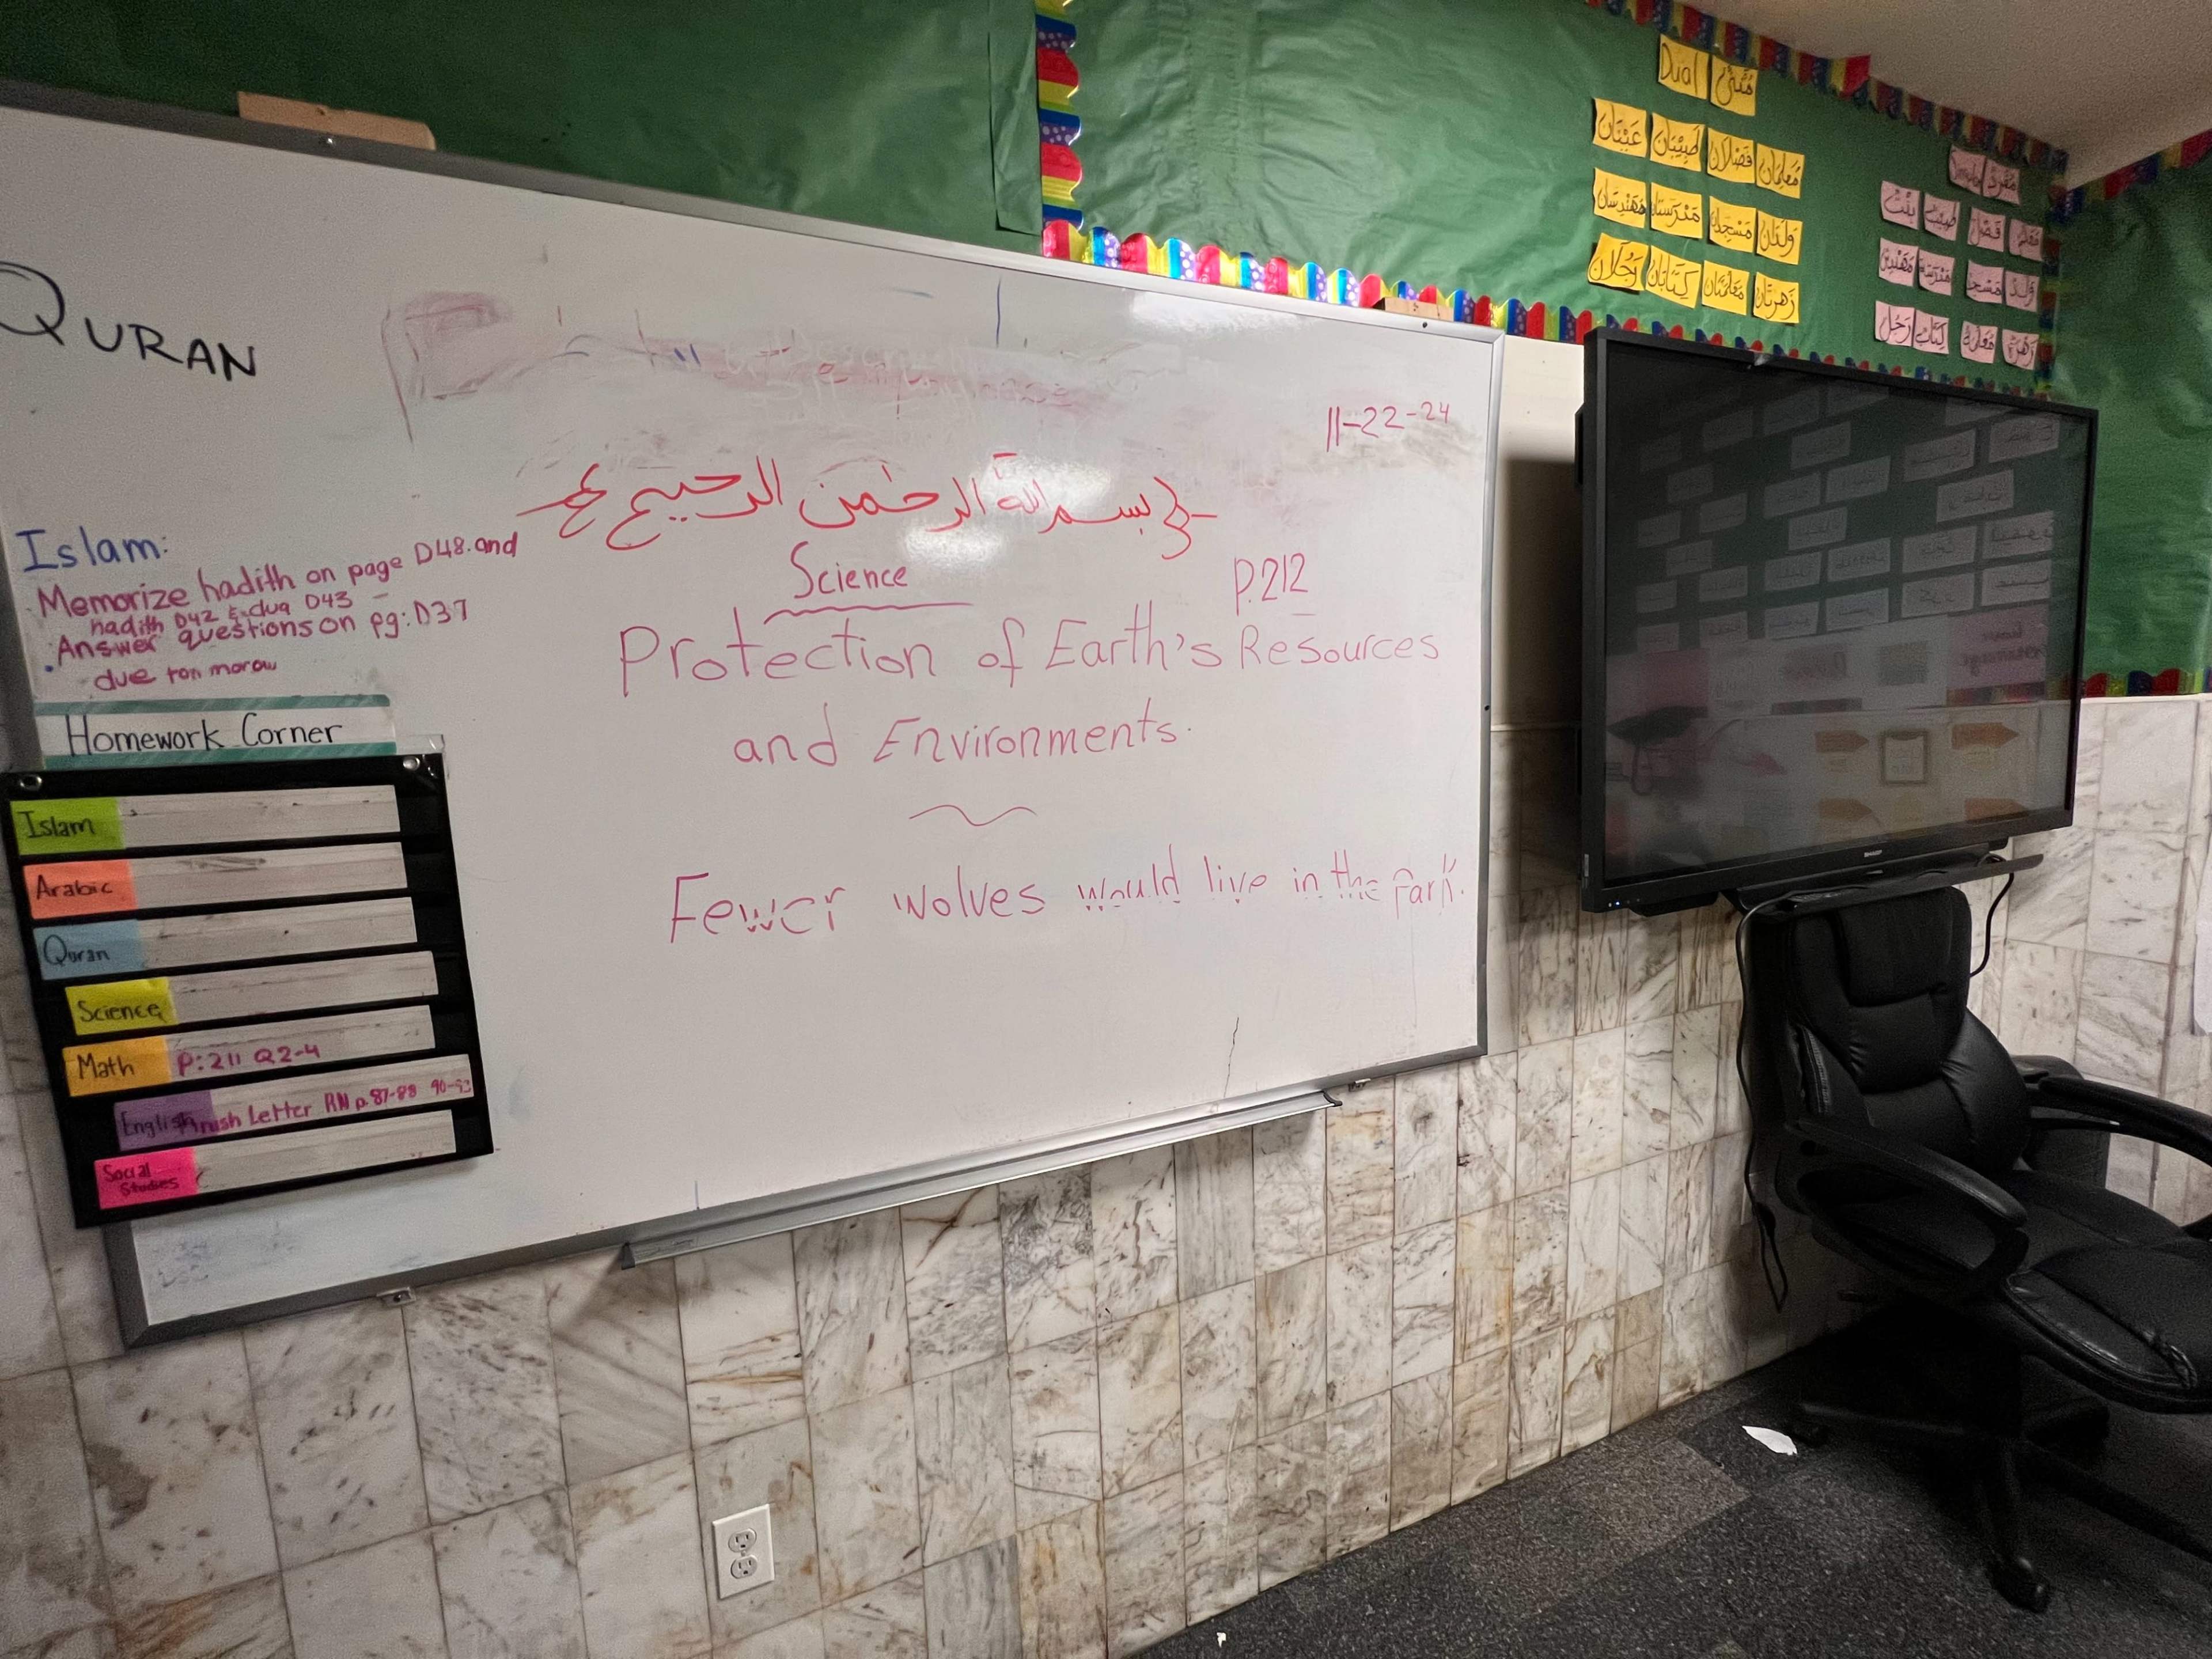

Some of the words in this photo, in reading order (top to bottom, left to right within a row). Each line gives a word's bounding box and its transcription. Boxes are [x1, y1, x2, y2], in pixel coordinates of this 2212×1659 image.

[1660, 42, 1698, 96] Dual
[0, 260, 256, 382] QURAN
[1325, 400, 1450, 453] 11-22-24
[16, 525, 168, 573] Islam:
[790, 540, 910, 600] Science
[37, 582, 191, 619] Memorize
[197, 563, 297, 603] hadith
[306, 567, 336, 584] on
[347, 556, 403, 586] page
[305, 590, 354, 611] D43
[58, 634, 159, 666] Answer
[177, 614, 314, 651] questions
[319, 614, 356, 635] on
[620, 606, 938, 698] Protection
[978, 617, 1025, 688] of
[1046, 599, 1223, 671] Earth's
[1240, 624, 1440, 669] Resources
[94, 668, 157, 691] due
[65, 714, 225, 756] Homework
[241, 712, 344, 748] Corner
[733, 702, 838, 767] and
[24, 810, 95, 838] Islam
[36, 874, 113, 901] Arabic
[893, 864, 1046, 921] wolves
[1292, 865, 1325, 900] in
[42, 933, 111, 965] Quran
[77, 1000, 167, 1023] Science
[76, 1052, 135, 1080] Math
[103, 1161, 151, 1183] Social
